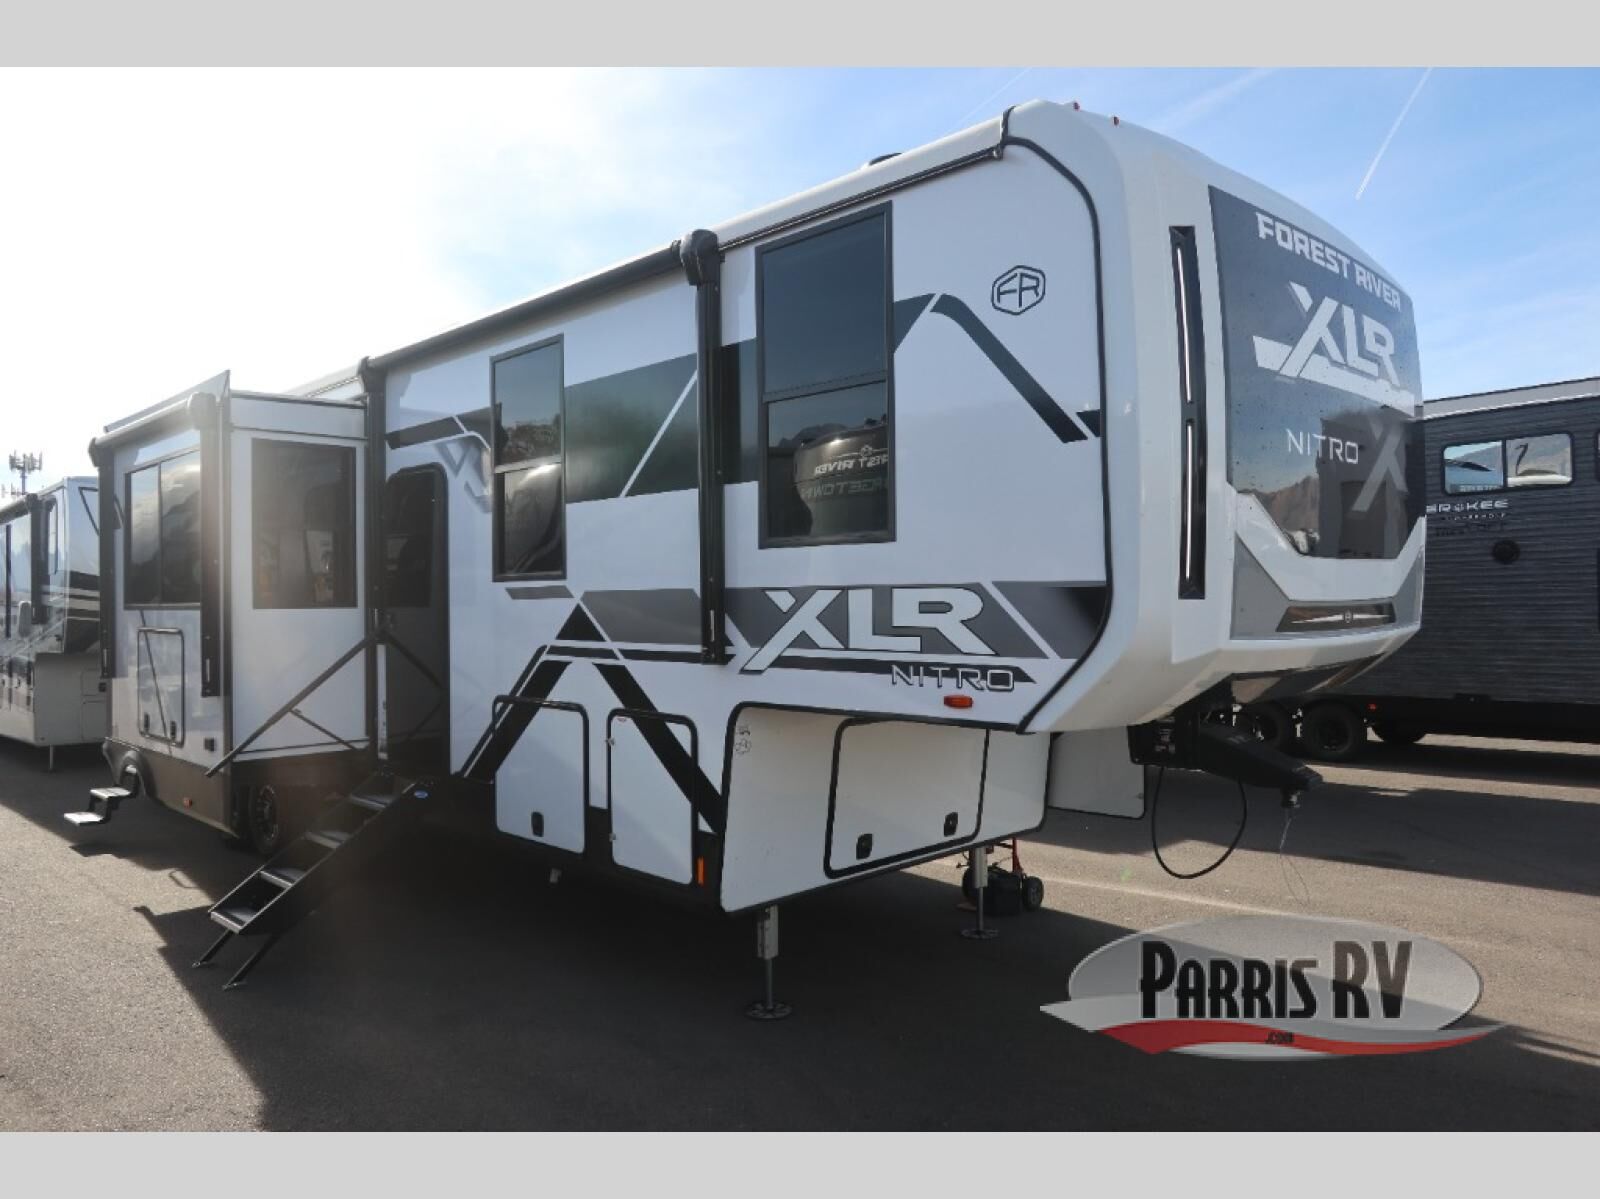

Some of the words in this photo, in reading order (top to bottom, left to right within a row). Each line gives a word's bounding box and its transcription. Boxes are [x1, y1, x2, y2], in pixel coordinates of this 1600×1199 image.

[1255, 211, 1350, 279] FOREST
[1353, 262, 1401, 313] RIVER
[1277, 281, 1399, 385] XLR
[1286, 428, 1359, 465] NITRO
[739, 588, 999, 674] XLR
[890, 664, 1015, 692] NITRO
